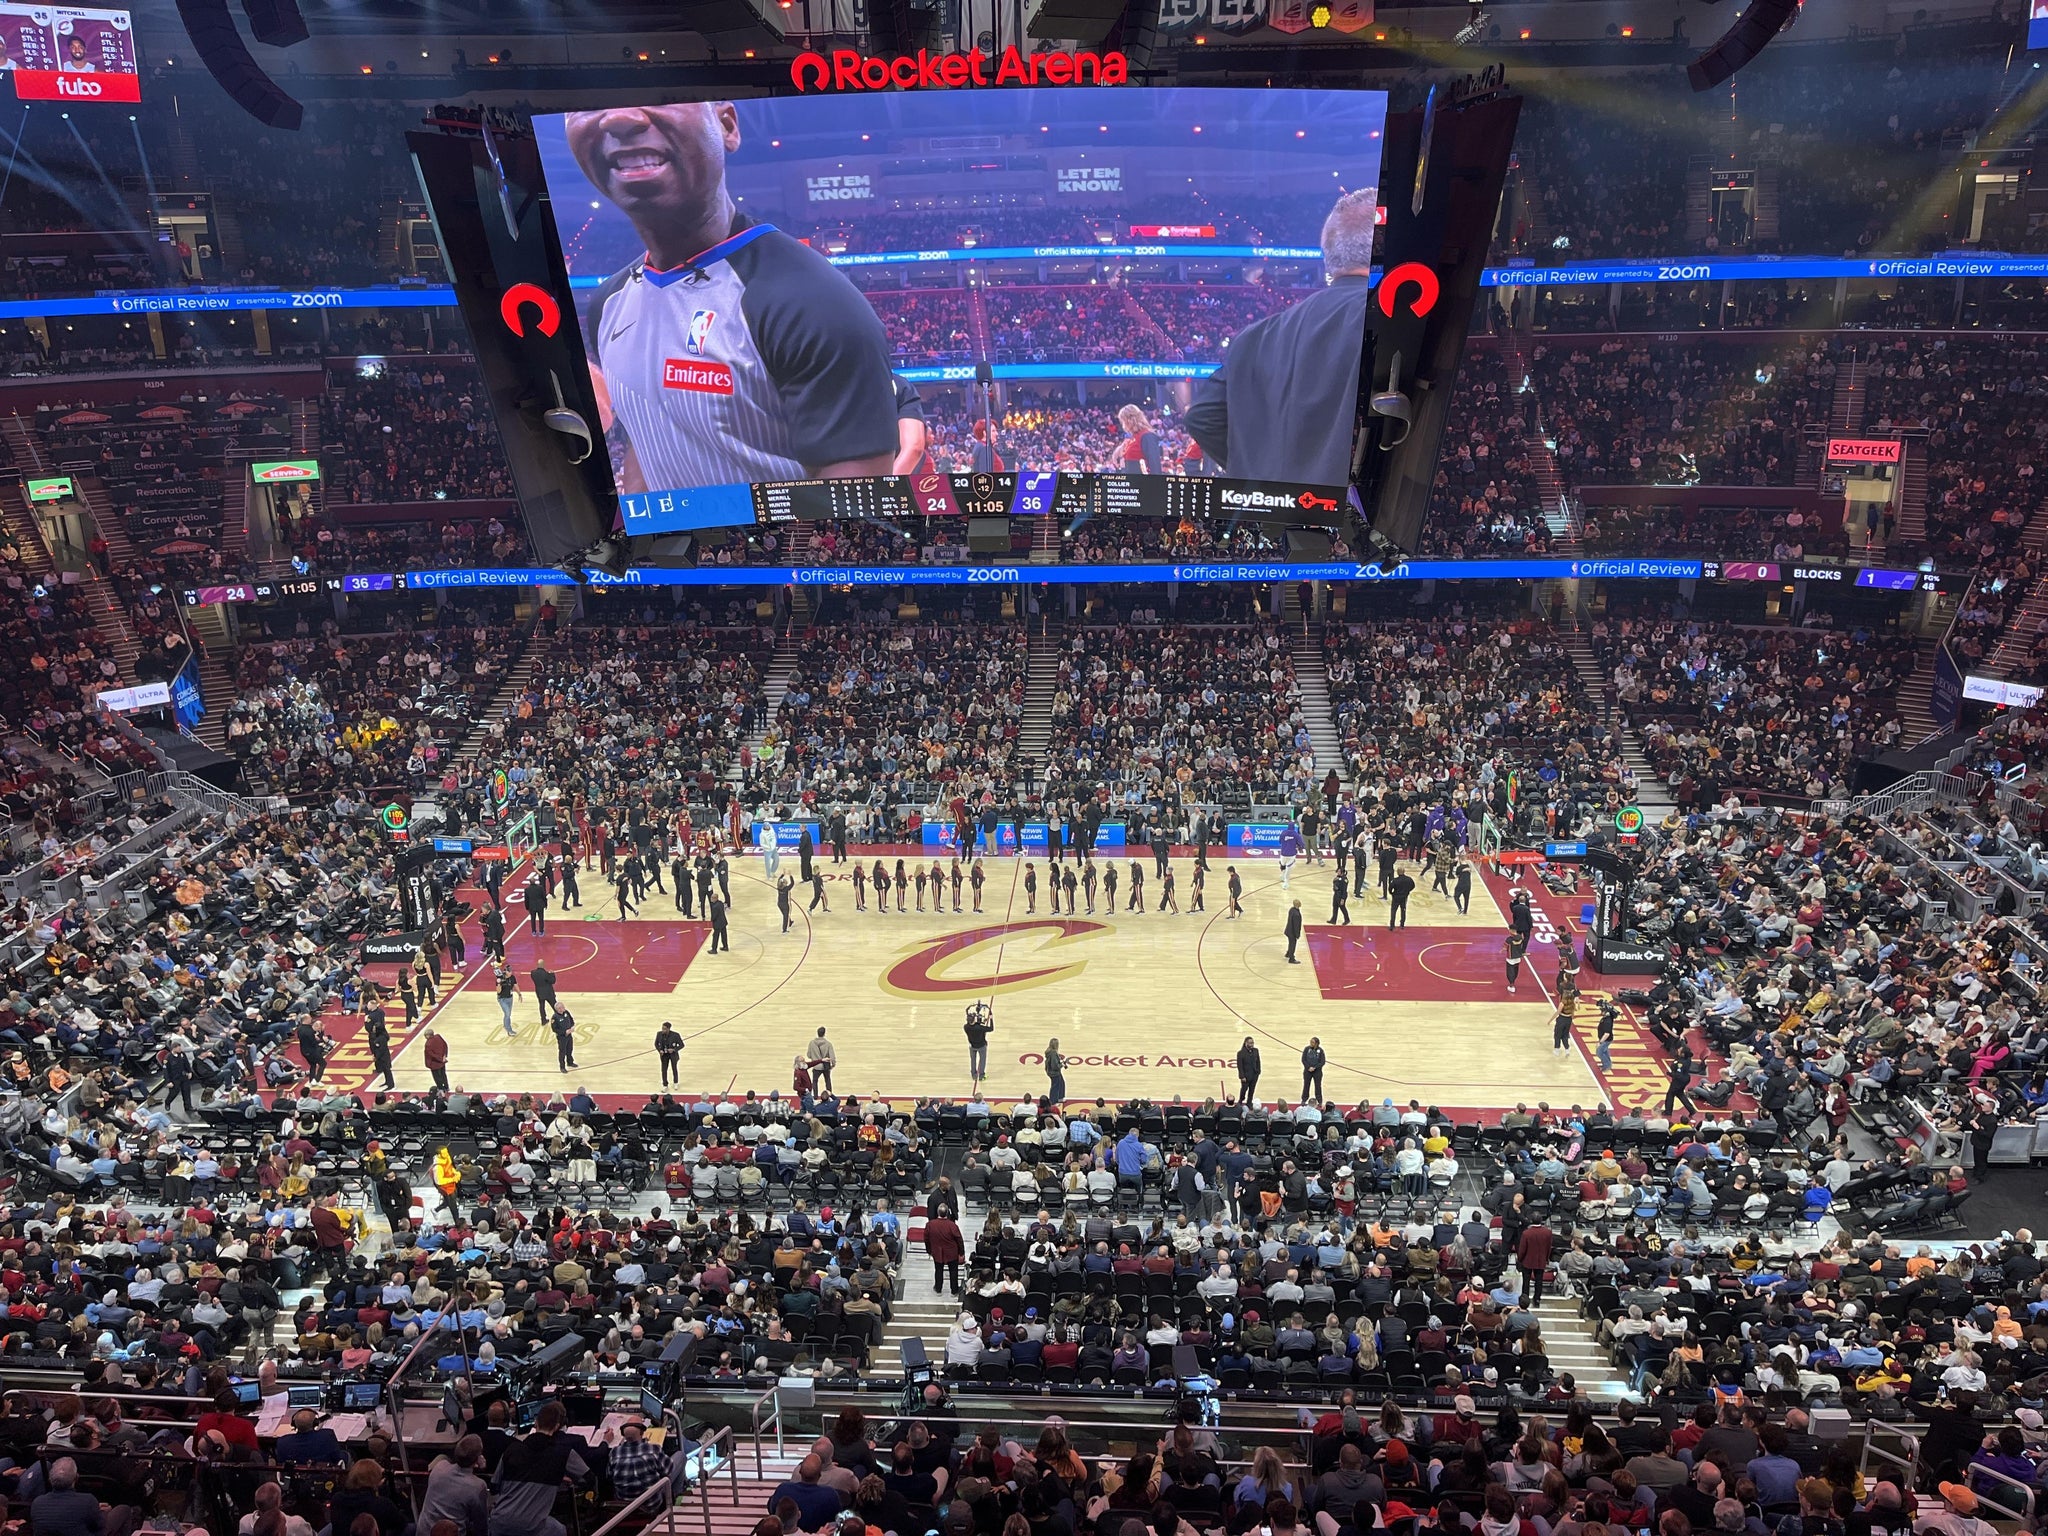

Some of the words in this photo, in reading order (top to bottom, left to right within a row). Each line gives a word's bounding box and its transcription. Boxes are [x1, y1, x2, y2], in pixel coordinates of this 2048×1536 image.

[34, 12, 48, 20] 35
[833, 47, 987, 90] Rocket
[995, 44, 1127, 86] Arena
[56, 76, 102, 96] fubo
[1058, 168, 1092, 180] LET
[1094, 168, 1120, 178] EM
[807, 177, 842, 188] LET
[844, 176, 870, 186] EM
[1058, 178, 1123, 192] KNOW.
[809, 187, 875, 201] KNOW.
[853, 254, 884, 262] Review
[918, 250, 949, 260] zoom
[1039, 248, 1068, 256] Official
[1070, 246, 1100, 255] Review
[1134, 245, 1166, 256] zoom
[1258, 248, 1288, 256] Official
[1289, 248, 1321, 258] Review
[1878, 261, 1932, 275] Official
[1936, 260, 1993, 274] Review
[2000, 264, 2045, 272] presented
[1500, 271, 1547, 284] Official
[1550, 270, 1598, 282] Review
[1604, 270, 1642, 278] presented
[1643, 270, 1653, 278] by
[1658, 266, 1710, 279] zoom
[122, 298, 174, 310] Official
[178, 296, 230, 309] Review
[236, 297, 274, 306] presented
[276, 296, 286, 305] by
[292, 294, 342, 307] zoom
[666, 365, 731, 387] Emirates
[1112, 365, 1154, 376] Official
[1156, 365, 1196, 376] Review
[1832, 444, 1896, 458] SEATGEEK
[269, 468, 304, 478] SERVPRO
[954, 478, 969, 487] 2Q
[998, 478, 1011, 486] 14
[927, 498, 946, 511] 24
[966, 501, 1004, 512] 11:05
[1022, 497, 1042, 510] 36
[1221, 490, 1296, 508] KeyBank
[142, 512, 209, 526] Construction.
[800, 570, 850, 582] Official
[854, 570, 904, 582] Review
[911, 571, 950, 579] presented
[952, 571, 962, 580] by
[967, 568, 1018, 581] zoom
[1182, 567, 1234, 580] Official
[1238, 566, 1290, 579] Review
[1297, 567, 1336, 576] presented
[1338, 567, 1350, 576] by
[1580, 561, 1634, 576] Official
[1639, 562, 1696, 576] Review
[1704, 569, 1716, 577] 36
[1758, 566, 1766, 578] 0
[1794, 568, 1841, 580] BLOCKS
[1867, 573, 1873, 584] 1
[1924, 574, 1940, 582] FG%
[352, 577, 370, 589] 36
[423, 572, 472, 585] Official
[476, 572, 528, 584] Review
[1922, 582, 1935, 591] 48
[227, 588, 246, 600] 24
[257, 586, 271, 596] 2Q
[280, 582, 317, 595] 11:05
[326, 580, 340, 590] 14
[398, 580, 406, 589] 3
[188, 596, 196, 604] 0
[138, 691, 164, 699] ULTRA
[177, 684, 198, 701] COMCAST
[178, 693, 200, 709] BUSINESS
[366, 944, 402, 954] KeyBank
[1603, 951, 1643, 961] KeyBank
[1648, 1242, 1661, 1251] 45
